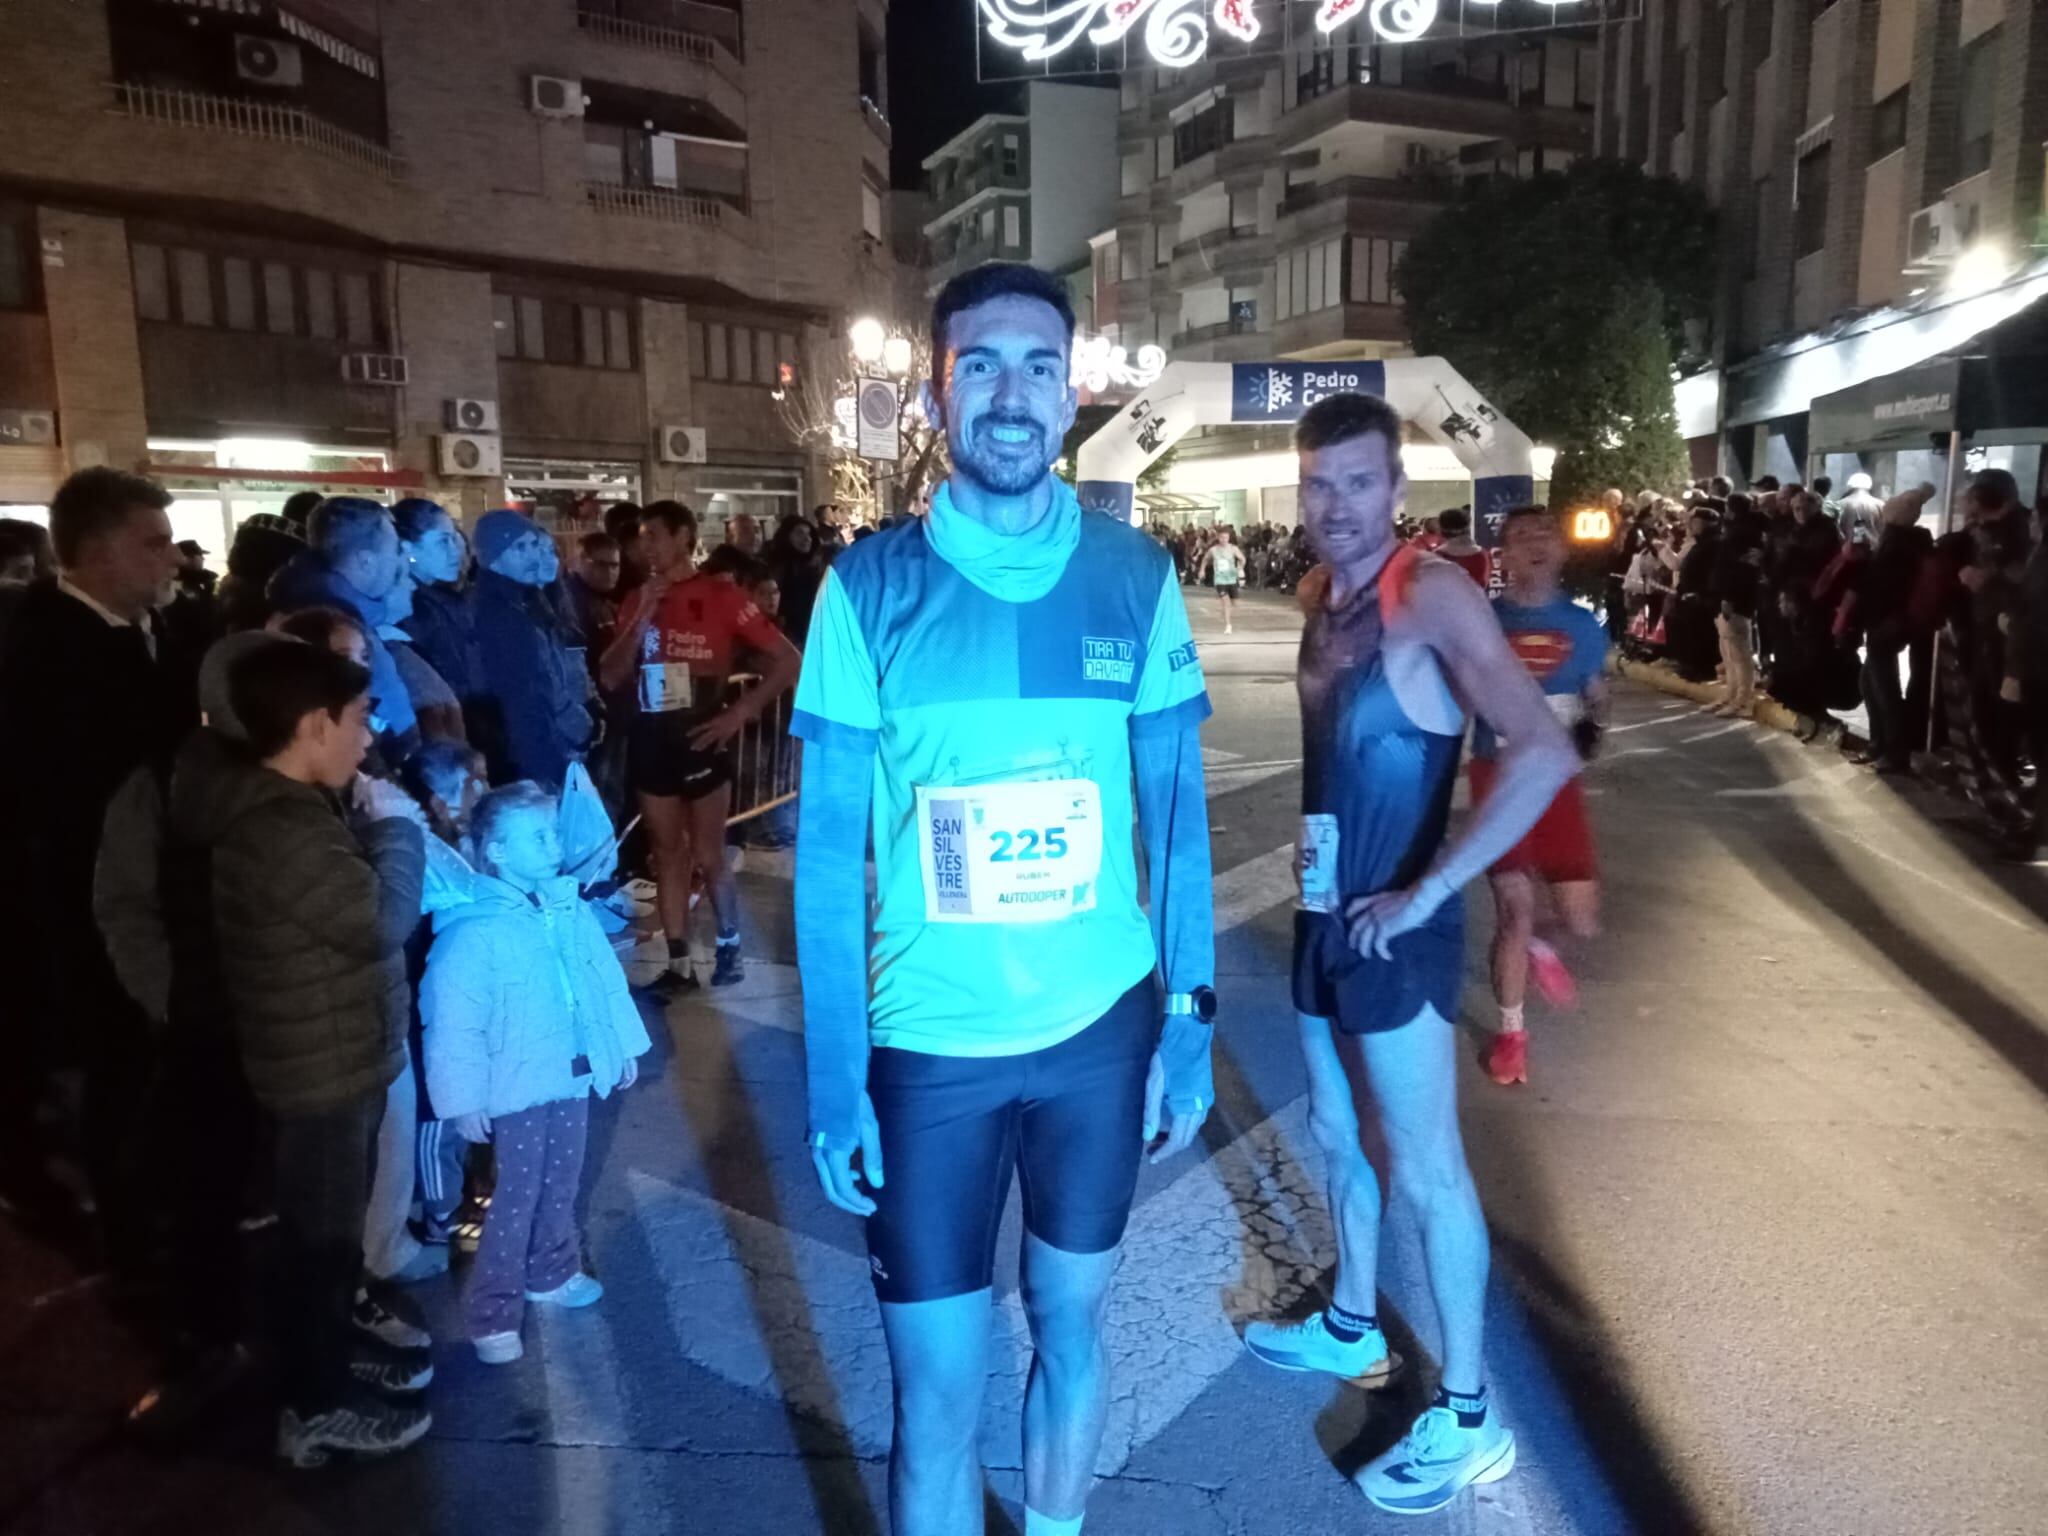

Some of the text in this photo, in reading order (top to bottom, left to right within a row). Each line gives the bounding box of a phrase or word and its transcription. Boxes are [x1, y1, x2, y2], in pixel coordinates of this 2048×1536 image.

[1303, 370, 1358, 387] Pedro
[1085, 640, 1133, 660] TIRA TU
[933, 818, 962, 836] SAN
[934, 836, 955, 854] SIL
[990, 827, 1068, 862] 225
[935, 855, 963, 871] VES
[937, 872, 963, 889] TRE
